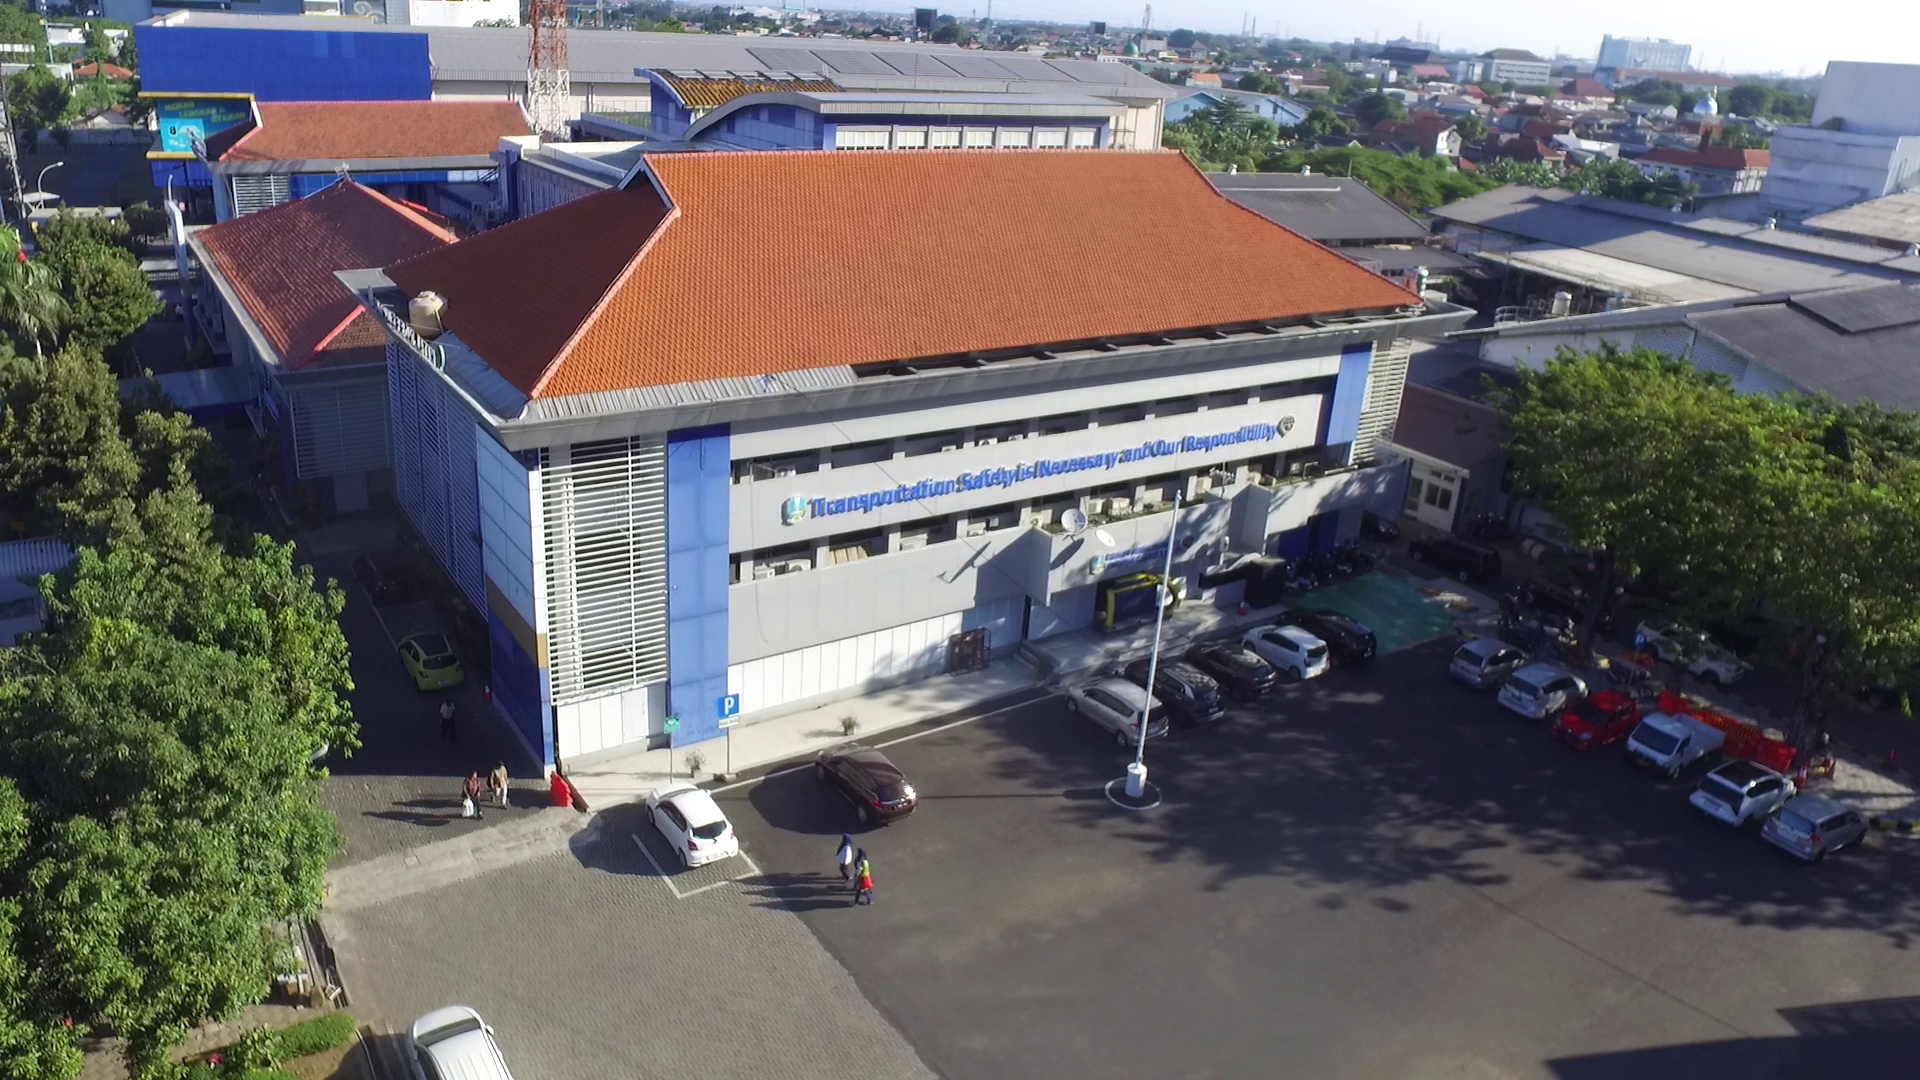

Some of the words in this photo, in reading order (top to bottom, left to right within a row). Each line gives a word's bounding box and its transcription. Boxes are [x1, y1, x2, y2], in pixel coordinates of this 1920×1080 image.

[813, 478, 955, 517] Transportation
[961, 467, 1017, 490] Safety
[1019, 463, 1033, 481] is
[1038, 452, 1119, 478] Necessary
[1121, 443, 1152, 463] and
[1155, 440, 1181, 456] Our
[1184, 423, 1276, 453] Responsibility
[724, 696, 735, 715] P
